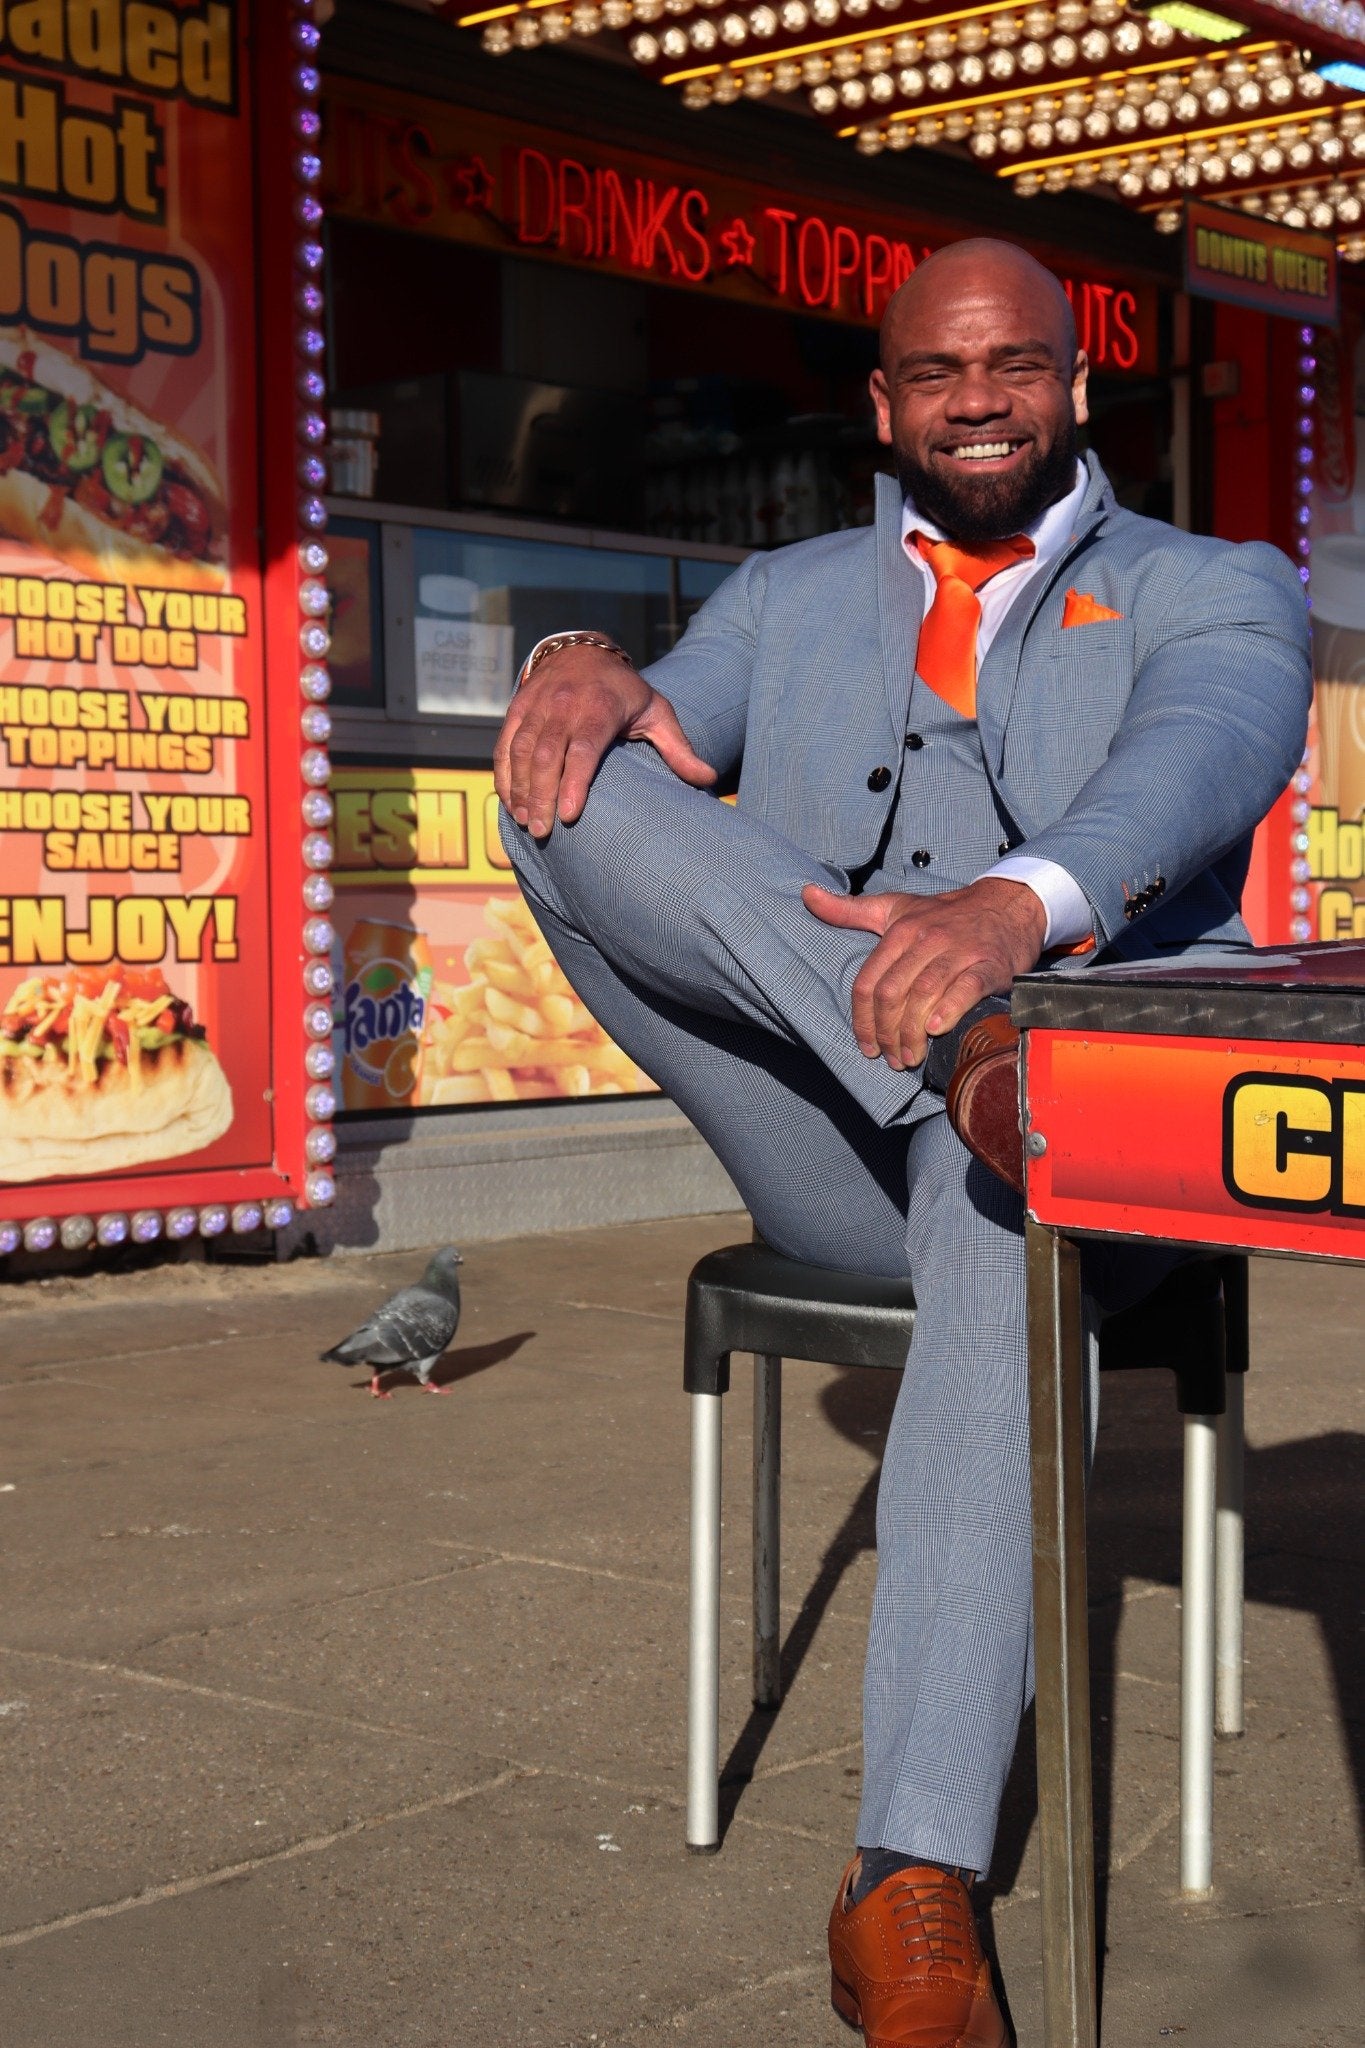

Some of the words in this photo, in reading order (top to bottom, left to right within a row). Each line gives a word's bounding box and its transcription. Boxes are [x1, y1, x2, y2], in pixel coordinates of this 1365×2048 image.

[0, 0, 234, 106] aded
[0, 78, 159, 217] Hot
[518, 147, 711, 281] DRINKS
[1197, 226, 1267, 284] DONUTS
[1272, 246, 1328, 298] QUEUE
[138, 587, 247, 635] YOUR
[16, 619, 99, 662] HOT
[112, 629, 198, 669] DOG
[138, 692, 248, 738] YOUR
[4, 728, 213, 772] TOPPINGS
[142, 794, 250, 835] YOUR
[45, 833, 180, 871] SAUCE
